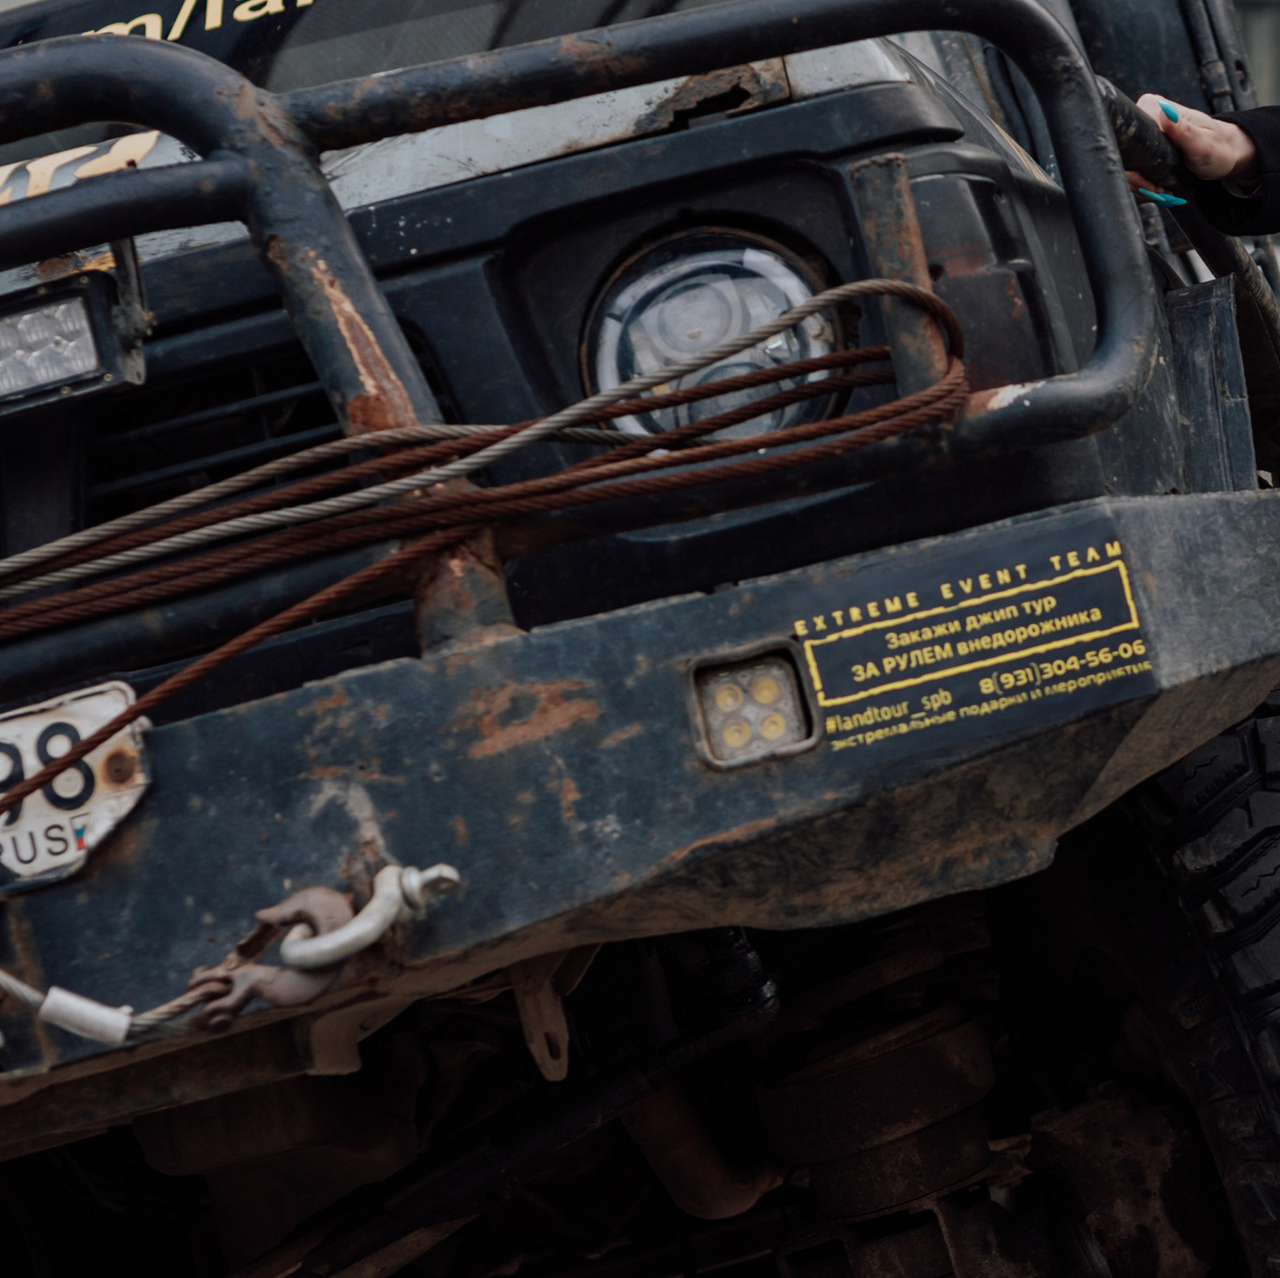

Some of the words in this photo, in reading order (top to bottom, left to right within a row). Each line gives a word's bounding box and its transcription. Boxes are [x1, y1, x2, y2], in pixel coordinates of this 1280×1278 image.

[794, 591, 920, 636] EXTREME
[940, 563, 1027, 599] EVENT
[1049, 540, 1122, 572] TEAM
[851, 661, 881, 682] ЗА
[882, 642, 954, 674] РУЛЕМ
[956, 607, 1103, 656] внедорожника
[885, 618, 962, 649] Закажи
[966, 604, 1019, 632] джип
[1021, 595, 1057, 616] тур
[825, 687, 953, 734] #landtour_spb
[979, 639, 1146, 695] 8(931)304-56-06
[959, 691, 1028, 718] подарки
[0, 824, 70, 866] US
